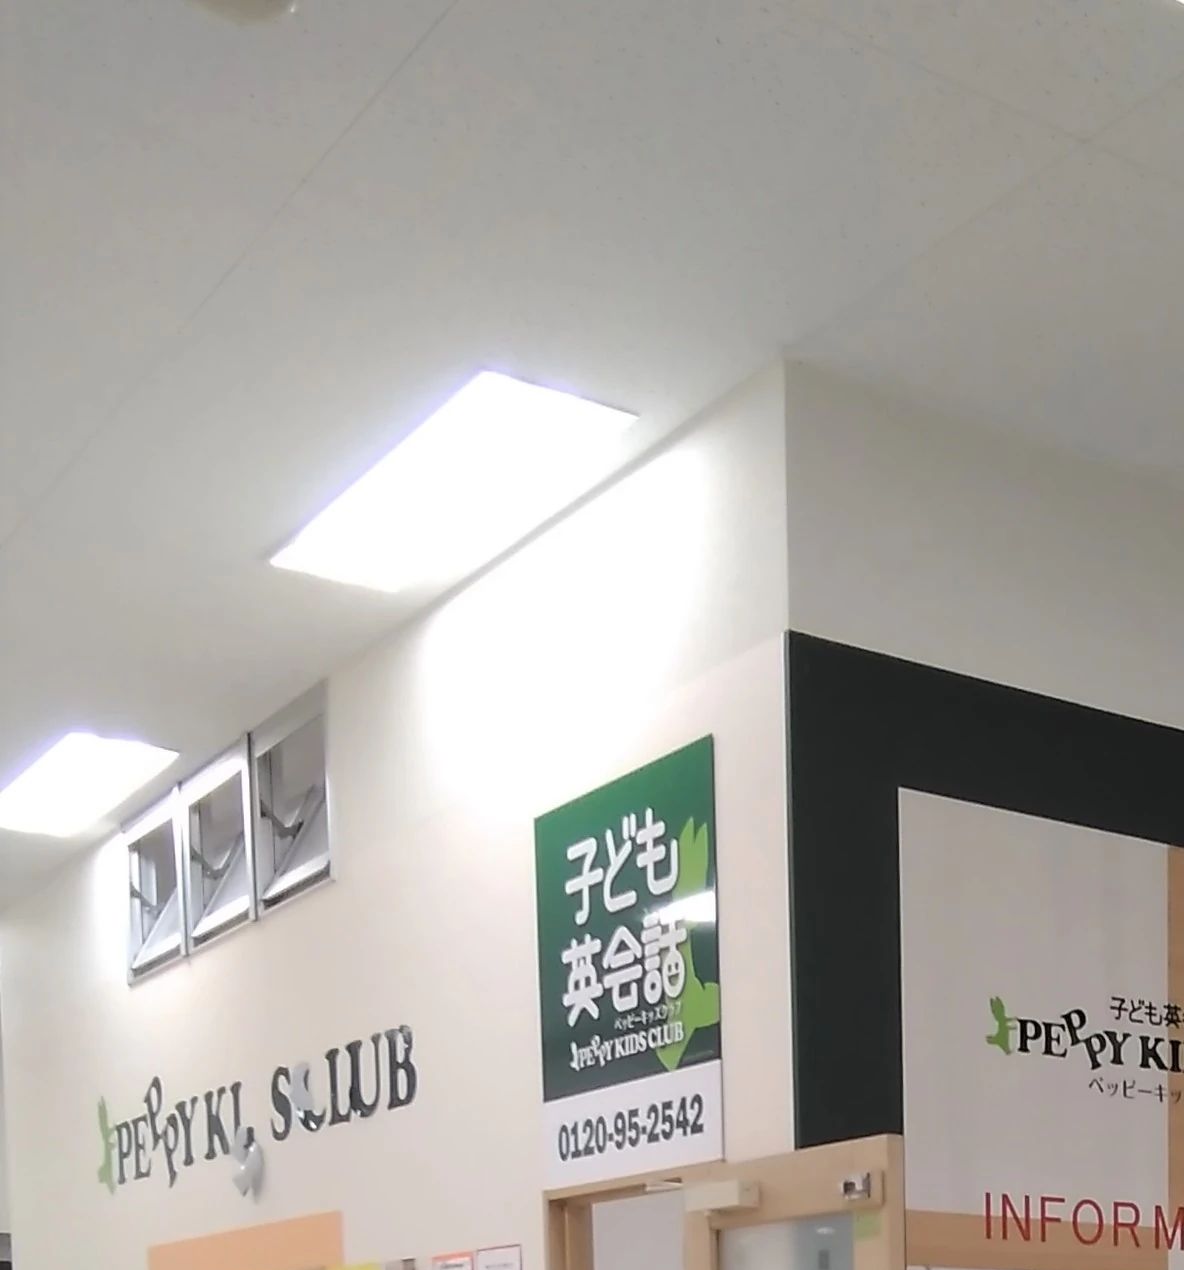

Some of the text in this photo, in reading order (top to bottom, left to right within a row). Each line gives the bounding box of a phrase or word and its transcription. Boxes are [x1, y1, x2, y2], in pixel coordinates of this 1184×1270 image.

[565, 807, 679, 926] 子ども
[562, 913, 687, 1027] 英会話
[579, 1021, 684, 1067] PEPPY KIDS CLUB
[1017, 1007, 1132, 1070] PEPPY
[115, 1076, 200, 1188] PEPPY
[204, 1065, 292, 1161] KIS
[558, 1094, 705, 1162] 0120-95-2542
